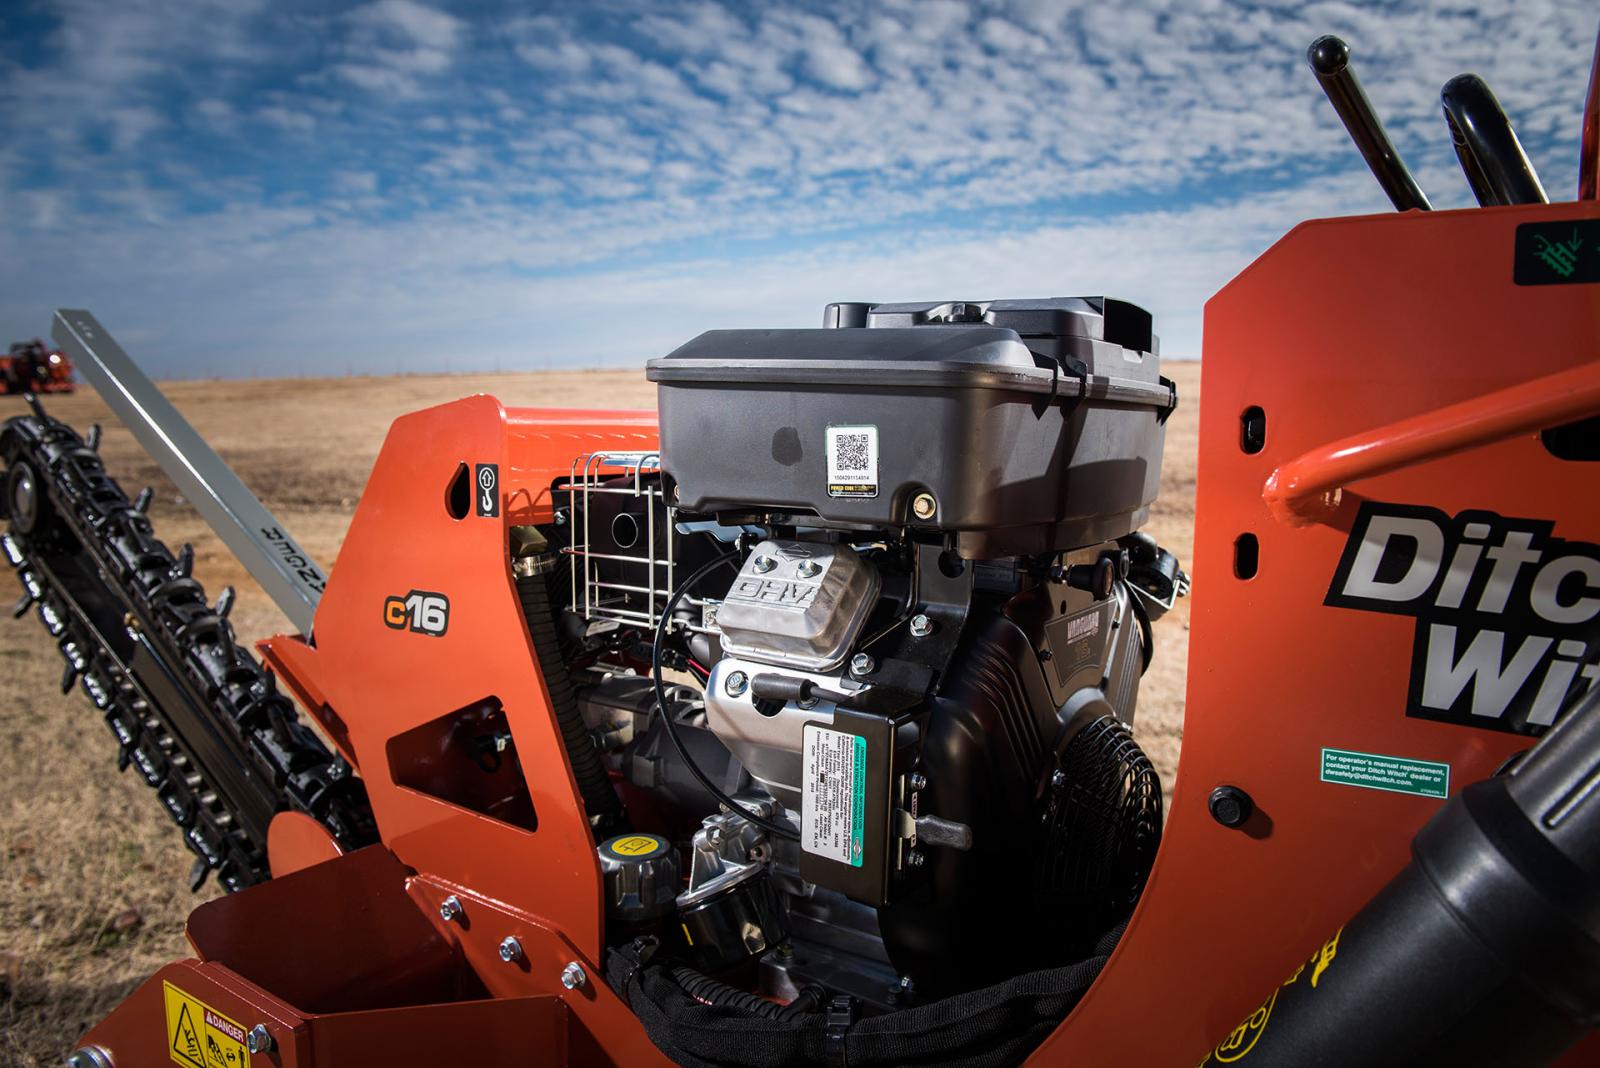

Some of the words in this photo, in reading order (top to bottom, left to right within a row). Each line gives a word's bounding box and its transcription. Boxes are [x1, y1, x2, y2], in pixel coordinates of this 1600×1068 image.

[739, 580, 815, 603] OHV
[1338, 756, 1372, 766] operator's
[1374, 760, 1398, 769] manual
[1400, 765, 1445, 776] replacement,
[1368, 766, 1385, 775] Ditch
[1410, 772, 1432, 781] dealer
[212, 1015, 244, 1042] DANGER
